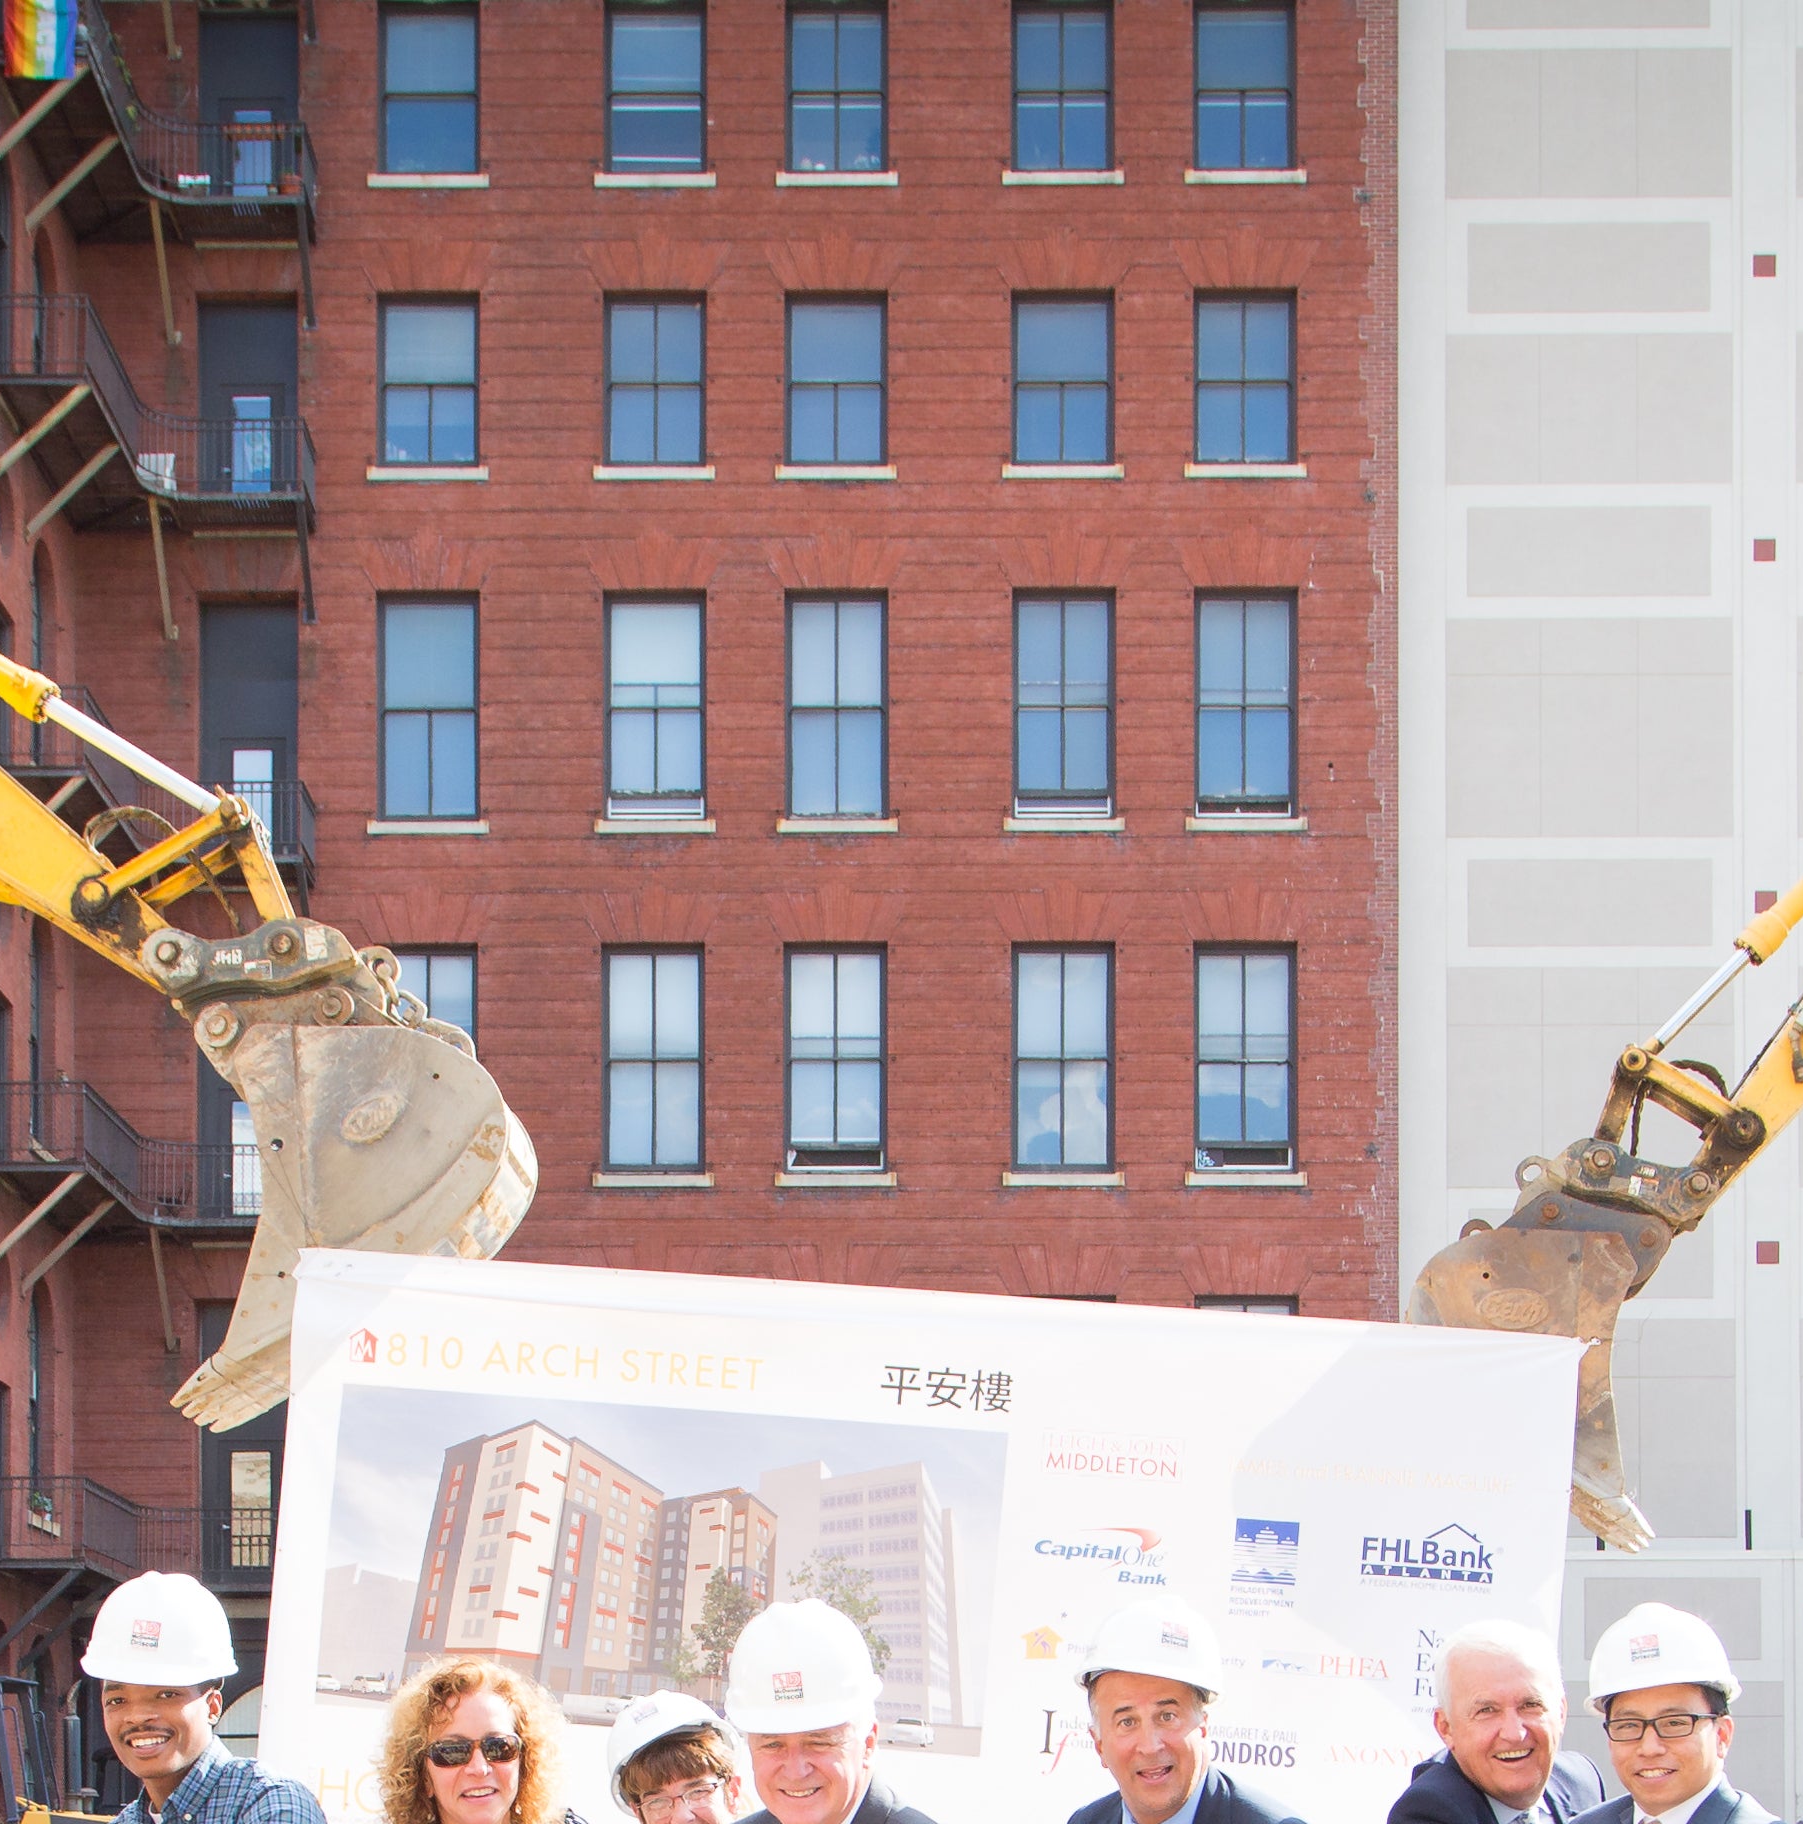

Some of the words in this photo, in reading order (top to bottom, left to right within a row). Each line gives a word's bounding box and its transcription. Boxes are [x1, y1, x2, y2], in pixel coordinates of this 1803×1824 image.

[387, 1333, 464, 1369] 810
[482, 1340, 599, 1379] ARCH
[620, 1349, 764, 1390] STREET
[880, 1364, 1014, 1413] 平安樓
[1046, 1451, 1178, 1478] MIDDLETON
[1361, 1536, 1494, 1570] FHLBank
[1118, 1570, 1167, 1586] Bank
[1363, 1563, 1492, 1583] ATLANTA
[1319, 1654, 1389, 1679] PHFA
[775, 1691, 804, 1701] Driscoll
[1273, 1730, 1299, 1744] PAUL
